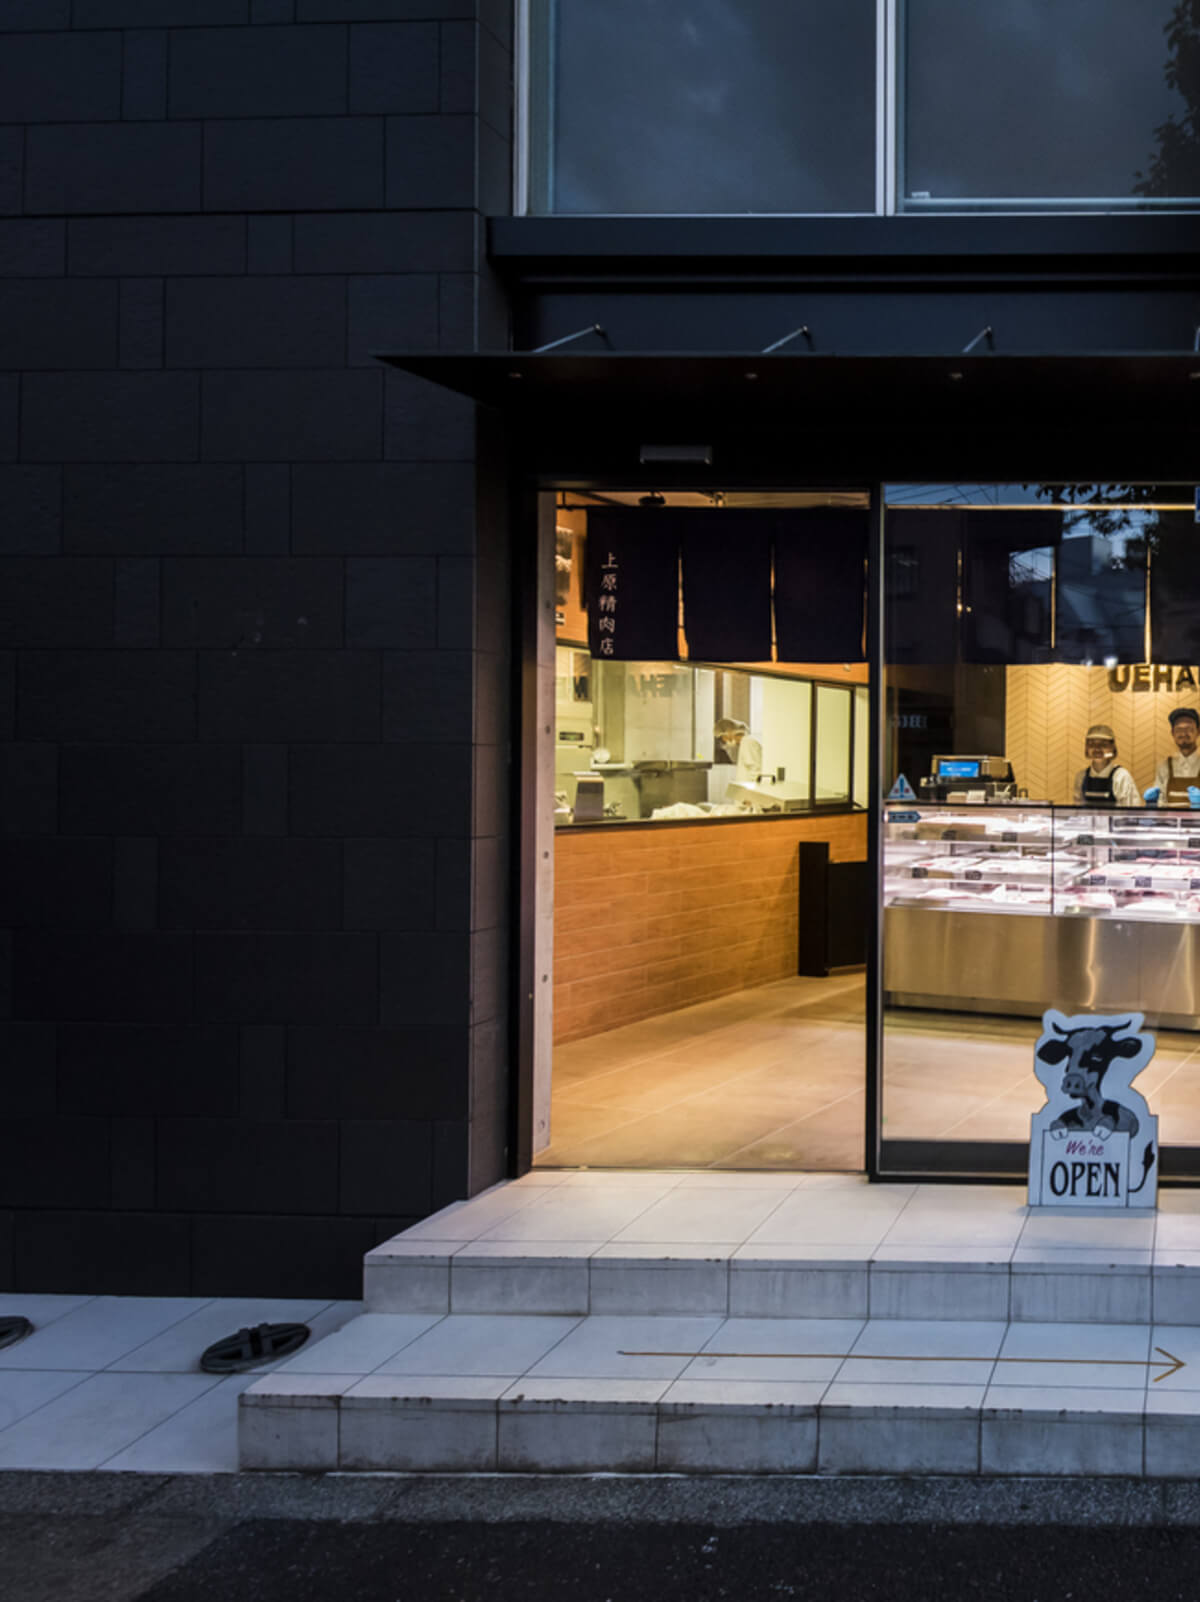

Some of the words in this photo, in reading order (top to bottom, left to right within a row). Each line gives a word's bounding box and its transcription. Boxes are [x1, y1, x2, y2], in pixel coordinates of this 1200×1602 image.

[599, 552, 619, 655] 上原精肉店
[1065, 1140, 1104, 1156] We're
[1050, 1161, 1120, 1197] OPEN
